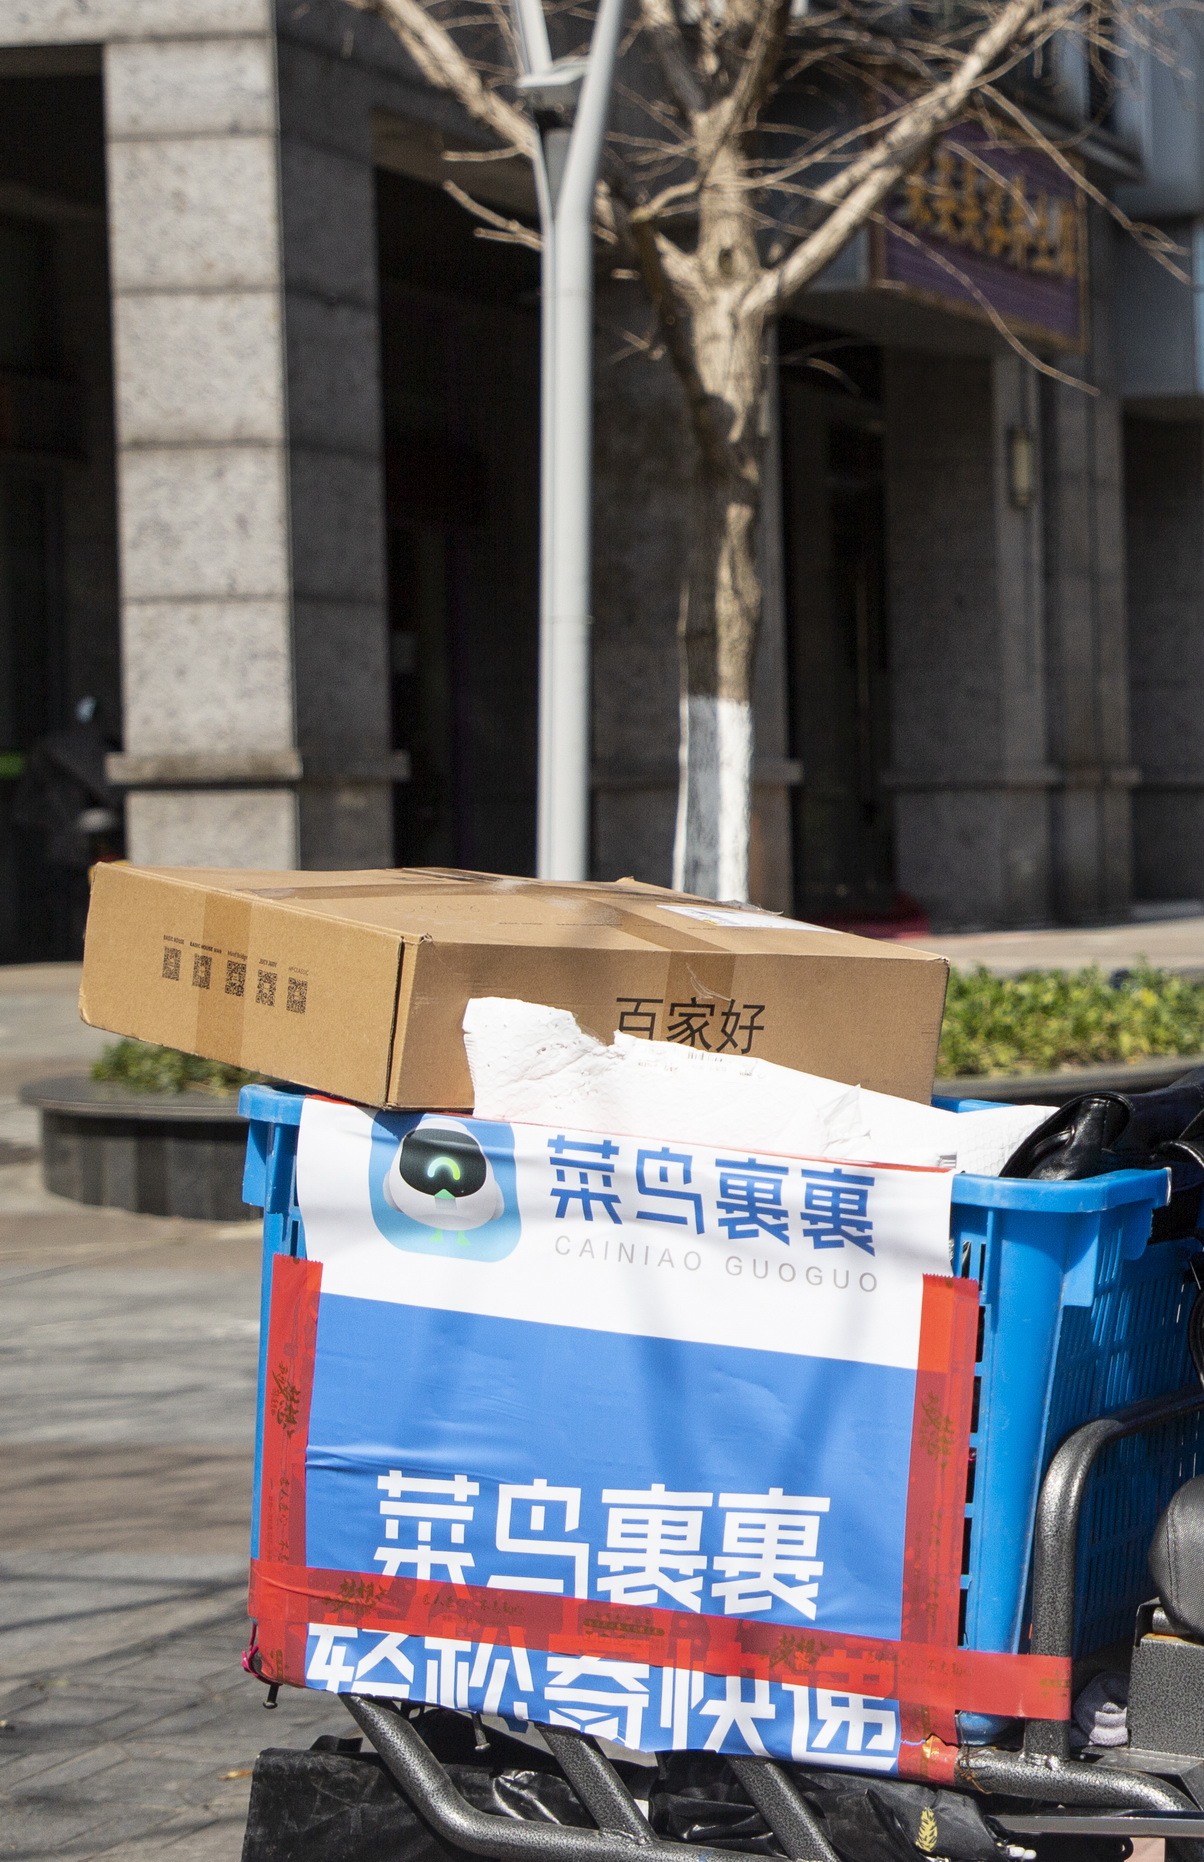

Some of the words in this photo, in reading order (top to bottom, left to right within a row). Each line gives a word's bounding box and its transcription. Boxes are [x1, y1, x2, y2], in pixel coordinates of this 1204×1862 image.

[616, 997, 766, 1054] 百家好
[547, 1133, 877, 1258] 菜鸟裹裹
[554, 1235, 703, 1273] CAINIAO
[725, 1256, 880, 1293] GUOGUO
[375, 1470, 831, 1622] 菜鸟裹裹
